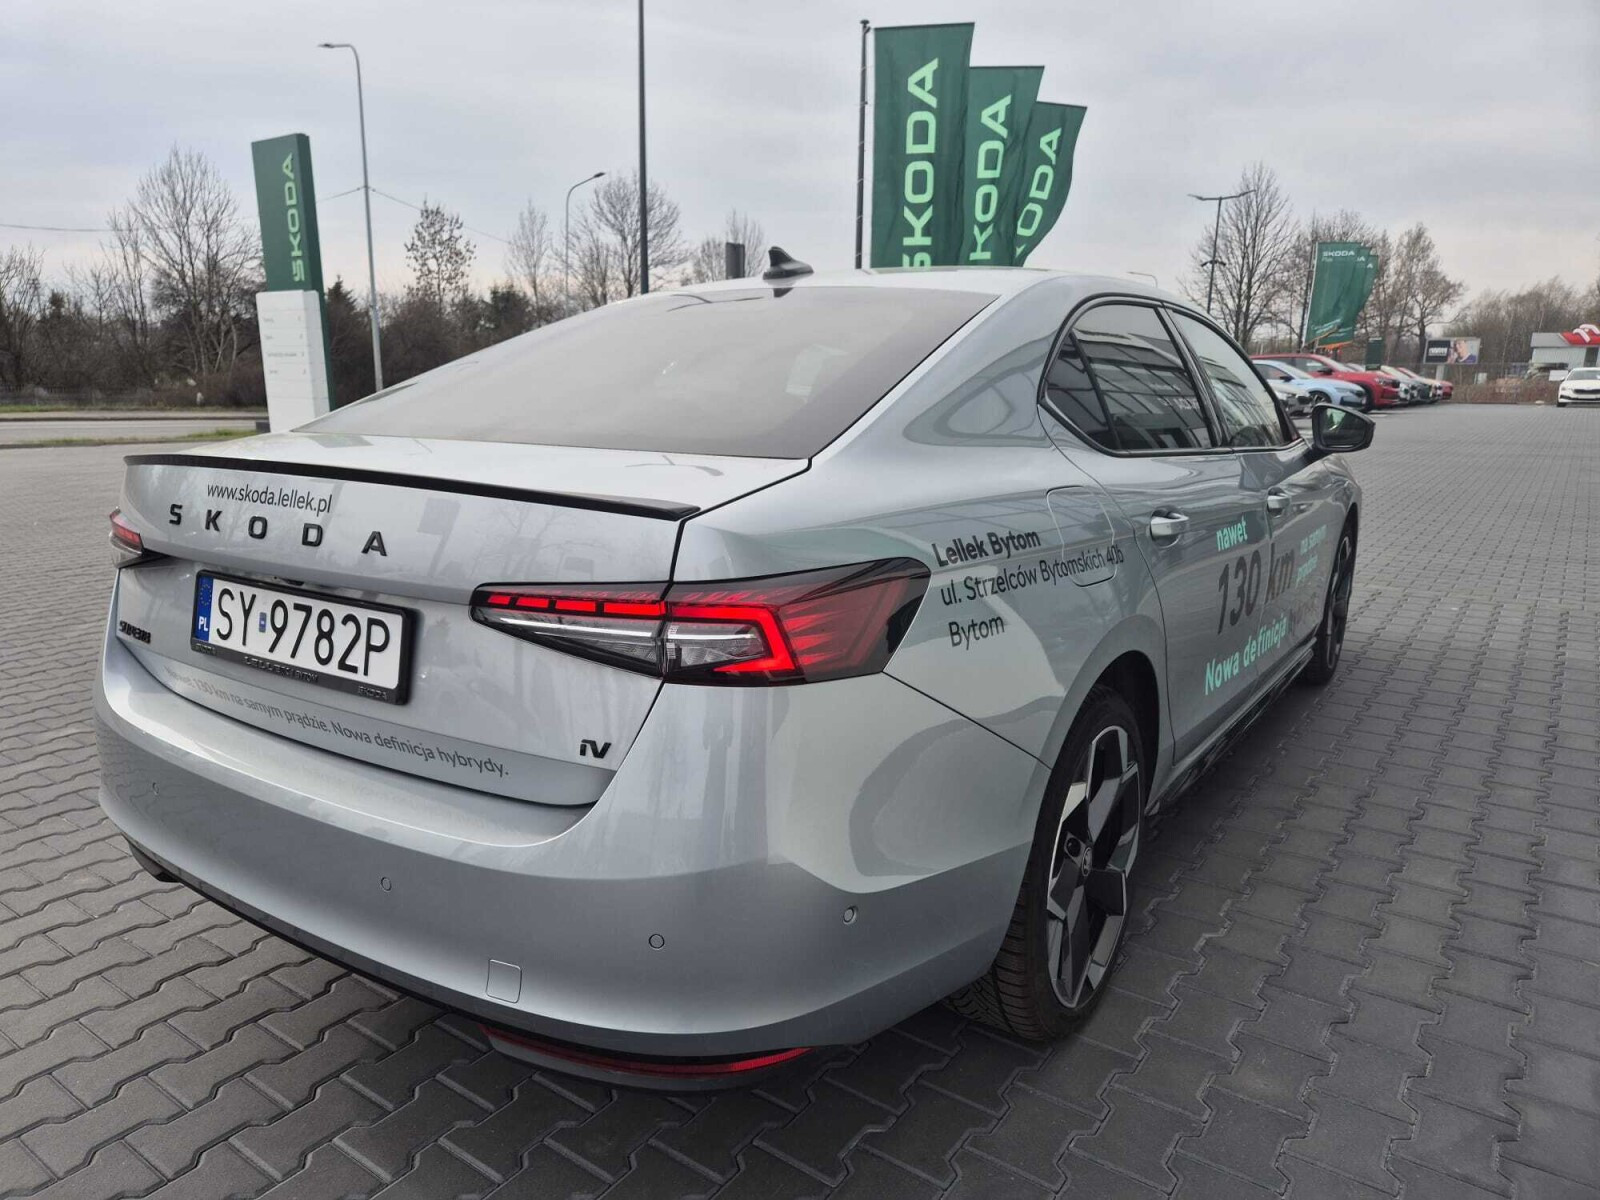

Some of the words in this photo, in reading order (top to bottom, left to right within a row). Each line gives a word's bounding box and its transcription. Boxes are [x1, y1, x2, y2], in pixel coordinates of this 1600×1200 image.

[282, 152, 305, 282] SKODA
[969, 94, 1012, 261] KODA
[1015, 127, 1062, 259] ODA
[207, 483, 333, 517] www.skoda.lellek.pl
[1216, 515, 1248, 552] nawet
[931, 534, 989, 567] Lellek
[987, 530, 1042, 559] Bytom
[940, 579, 962, 606] ul.
[963, 564, 1042, 601] Strzelców
[1039, 548, 1106, 586] Bytomskich
[1218, 549, 1262, 635] 130
[1264, 541, 1295, 605] km
[198, 615, 209, 632] PL
[216, 587, 257, 647] SY
[268, 599, 391, 677] 9782P
[948, 615, 1006, 651] Bytom
[1205, 651, 1240, 696] Nowa
[1243, 612, 1287, 668] definicja
[244, 698, 283, 719] samym
[284, 709, 332, 734] prądzie.
[330, 720, 372, 745] Nowa
[374, 732, 436, 762] definicja
[438, 747, 509, 777] hybrydy.
